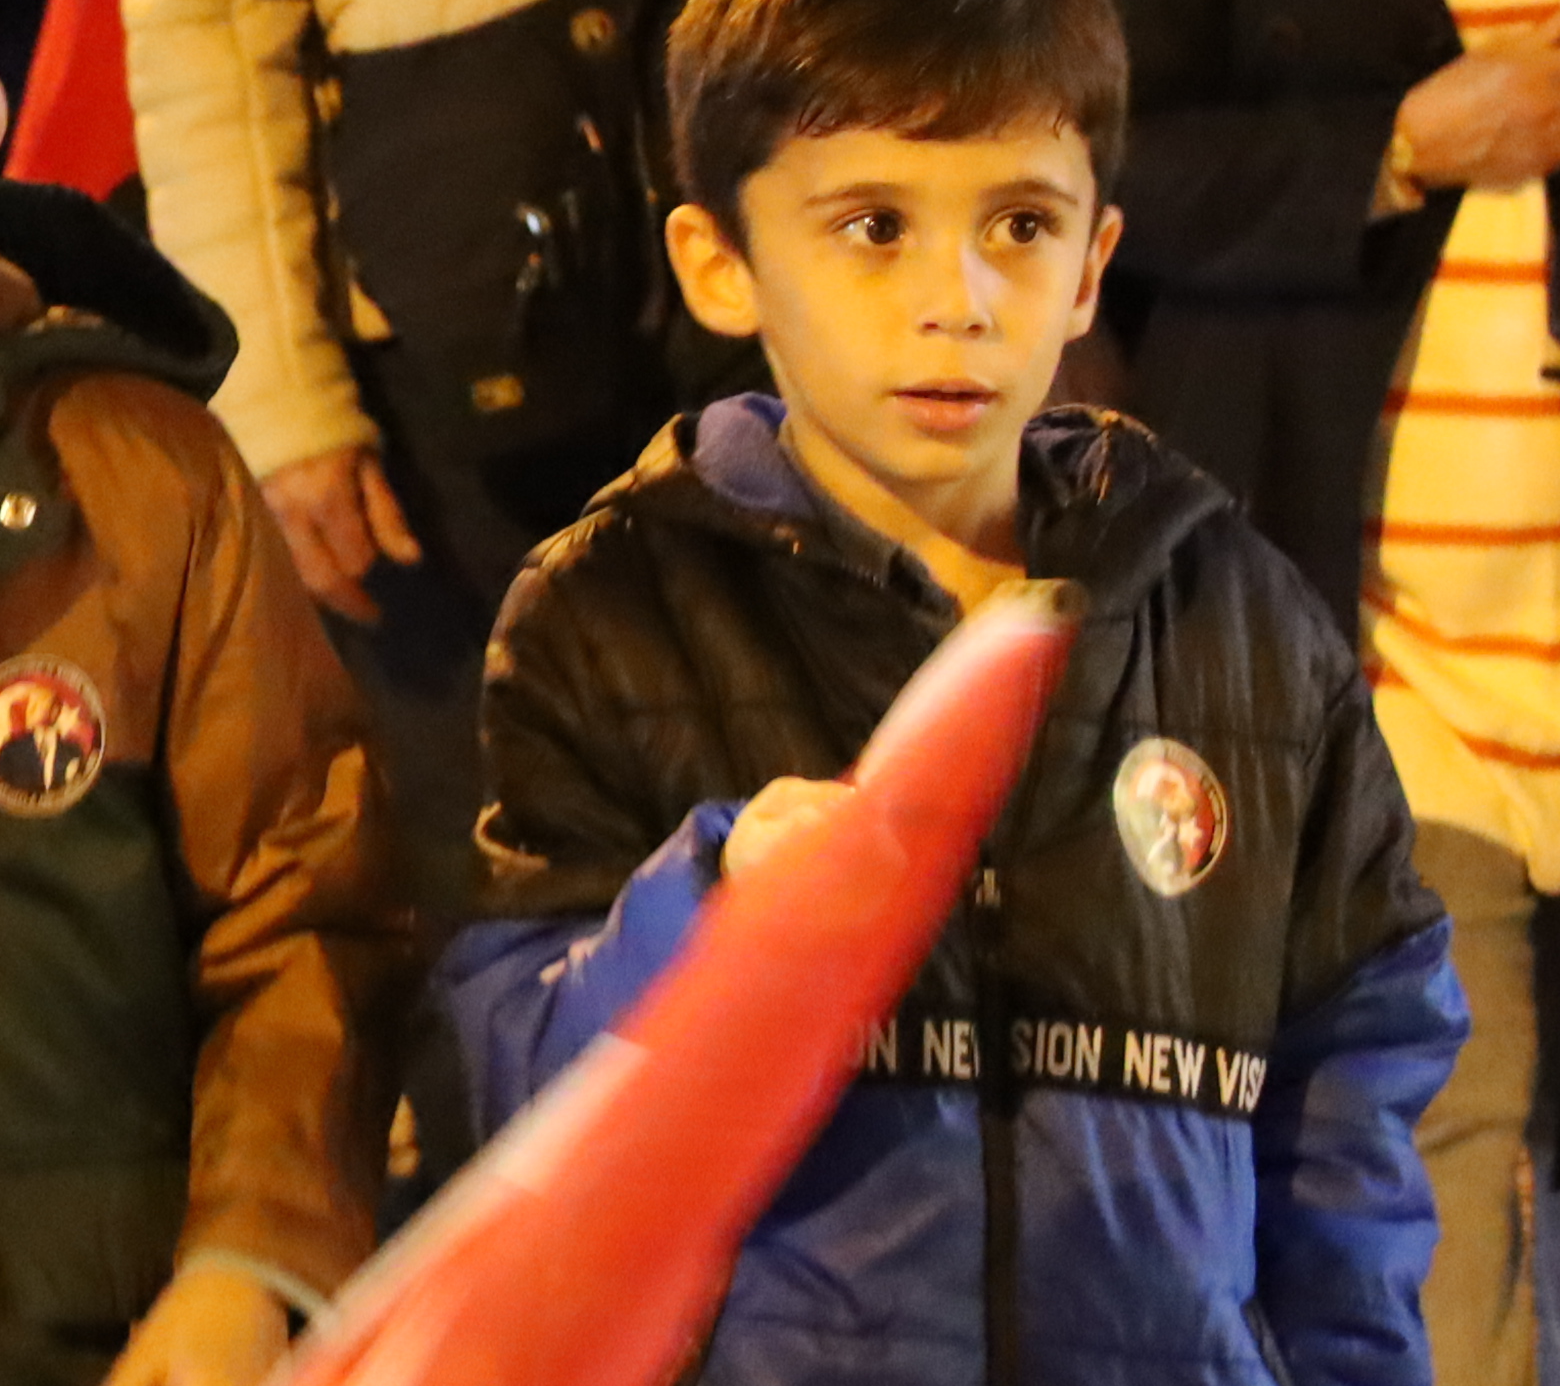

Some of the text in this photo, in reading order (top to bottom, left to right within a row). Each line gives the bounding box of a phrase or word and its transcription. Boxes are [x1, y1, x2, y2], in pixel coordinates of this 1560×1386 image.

[923, 1019, 978, 1079] NE
[1123, 1030, 1205, 1099] NEW
[1216, 1047, 1267, 1113] VIS
